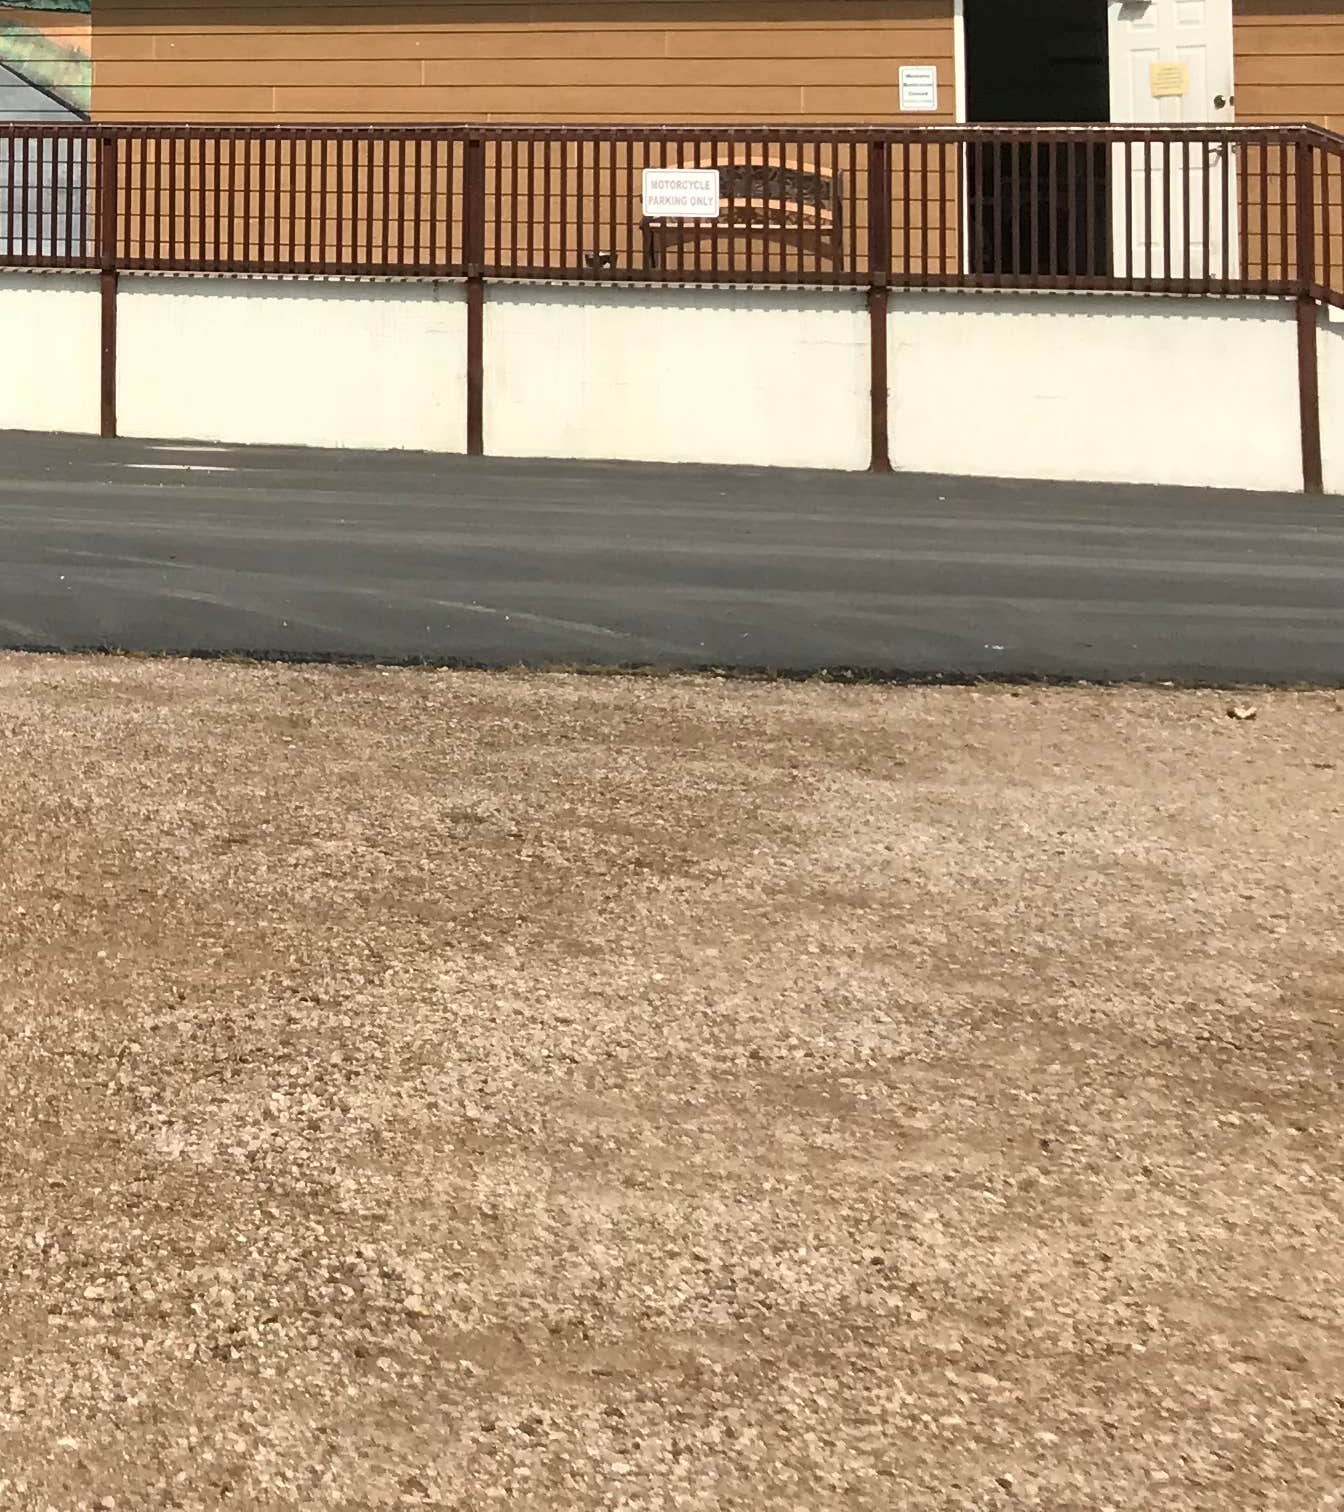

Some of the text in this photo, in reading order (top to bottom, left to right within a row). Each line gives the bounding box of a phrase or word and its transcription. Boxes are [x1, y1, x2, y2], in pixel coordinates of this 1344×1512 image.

[651, 180, 710, 190] MOTORCYCLE
[648, 196, 714, 206] PARKING ONLY
